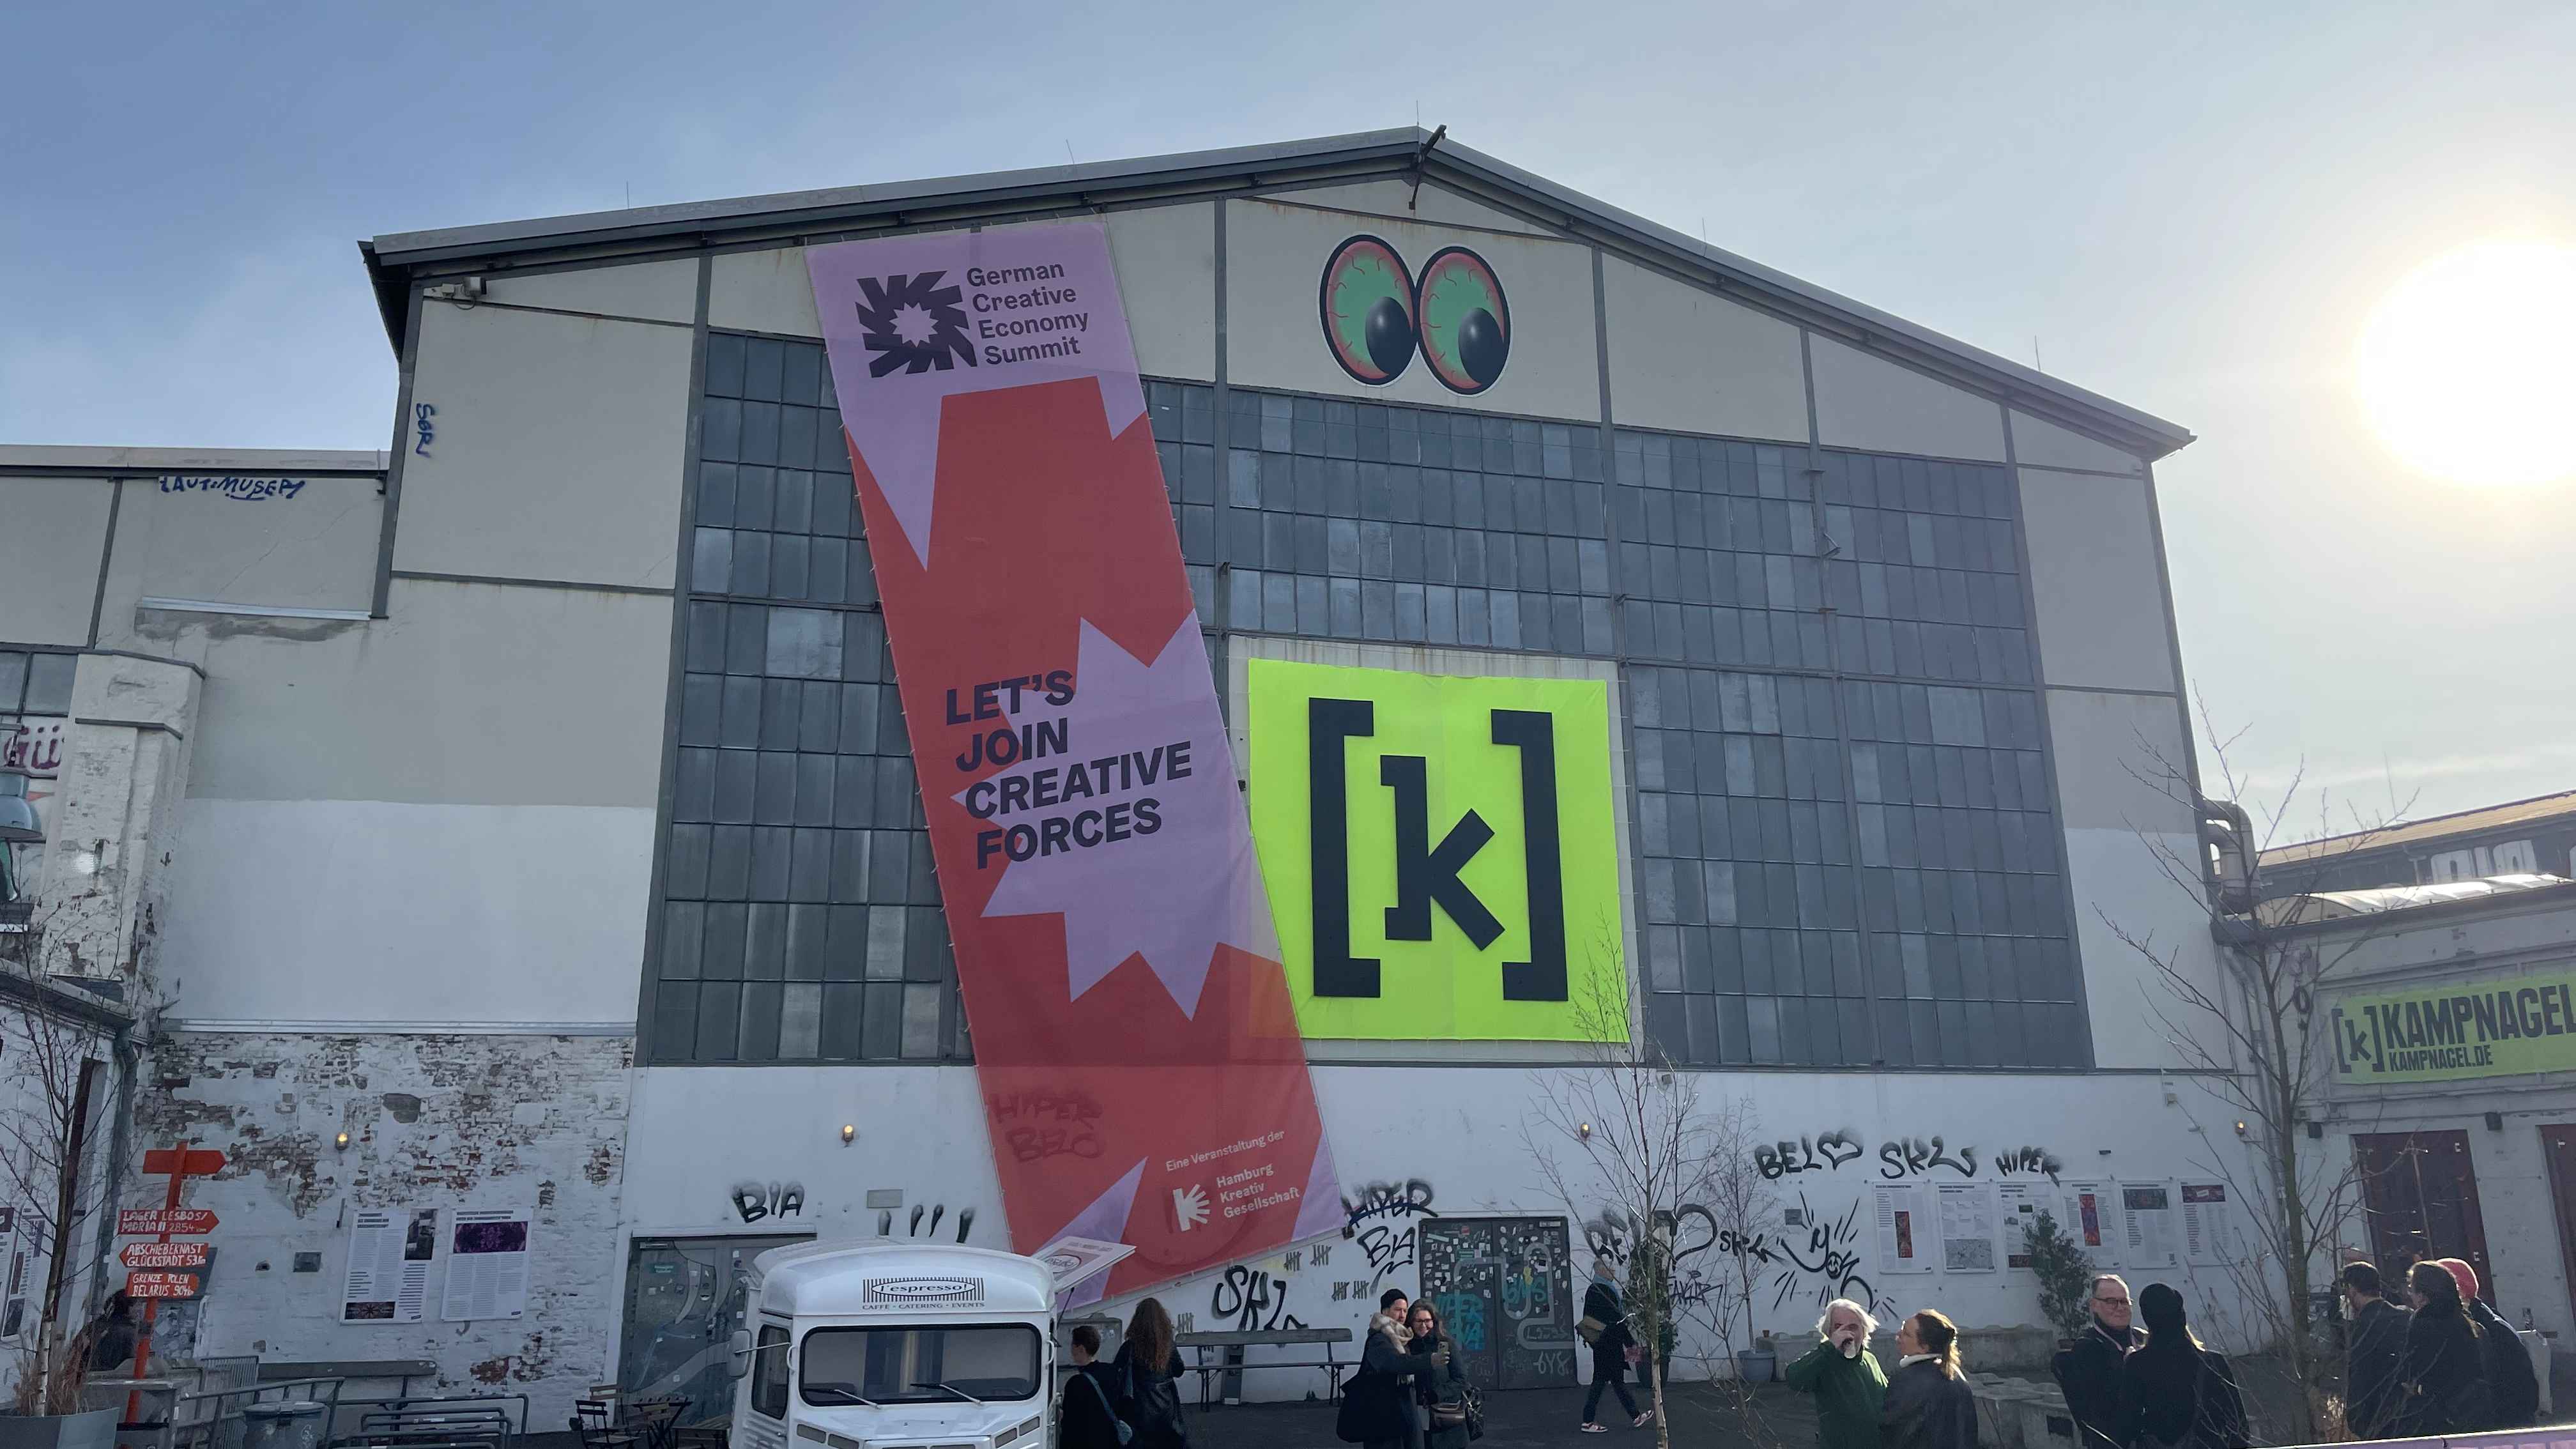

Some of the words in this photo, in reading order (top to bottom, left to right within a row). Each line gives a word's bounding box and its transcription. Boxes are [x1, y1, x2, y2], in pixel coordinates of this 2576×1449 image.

[967, 263, 1065, 287] German
[972, 285, 1077, 312] Creative
[978, 312, 1088, 339] Economy
[984, 335, 1081, 365] Summit
[946, 670, 1074, 726] LET'S
[956, 717, 1068, 772] JOIN
[965, 740, 1192, 819] CREATIVE
[977, 798, 1162, 870] FORCES
[2381, 983, 2576, 1050] KAMPNAGEL
[2389, 1044, 2493, 1072] KAMPNAGEL.DE
[1165, 1159, 1190, 1172] Eine
[1190, 1134, 1266, 1165] Veranstaltung
[1267, 1130, 1285, 1143] der
[1216, 1163, 1274, 1188] Hamburg
[732, 1179, 806, 1223] BIA
[1220, 1182, 1265, 1204] Kreativ
[1223, 1186, 1301, 1218] Gesellschaft
[121, 1221, 156, 1232] MORIA
[123, 1211, 157, 1222] LAGER
[126, 1243, 205, 1256] ABSCHIEBEKNAST
[132, 1273, 164, 1284] GRENZE
[167, 1273, 190, 1284] POLEN
[133, 1284, 170, 1297] BELARUS
